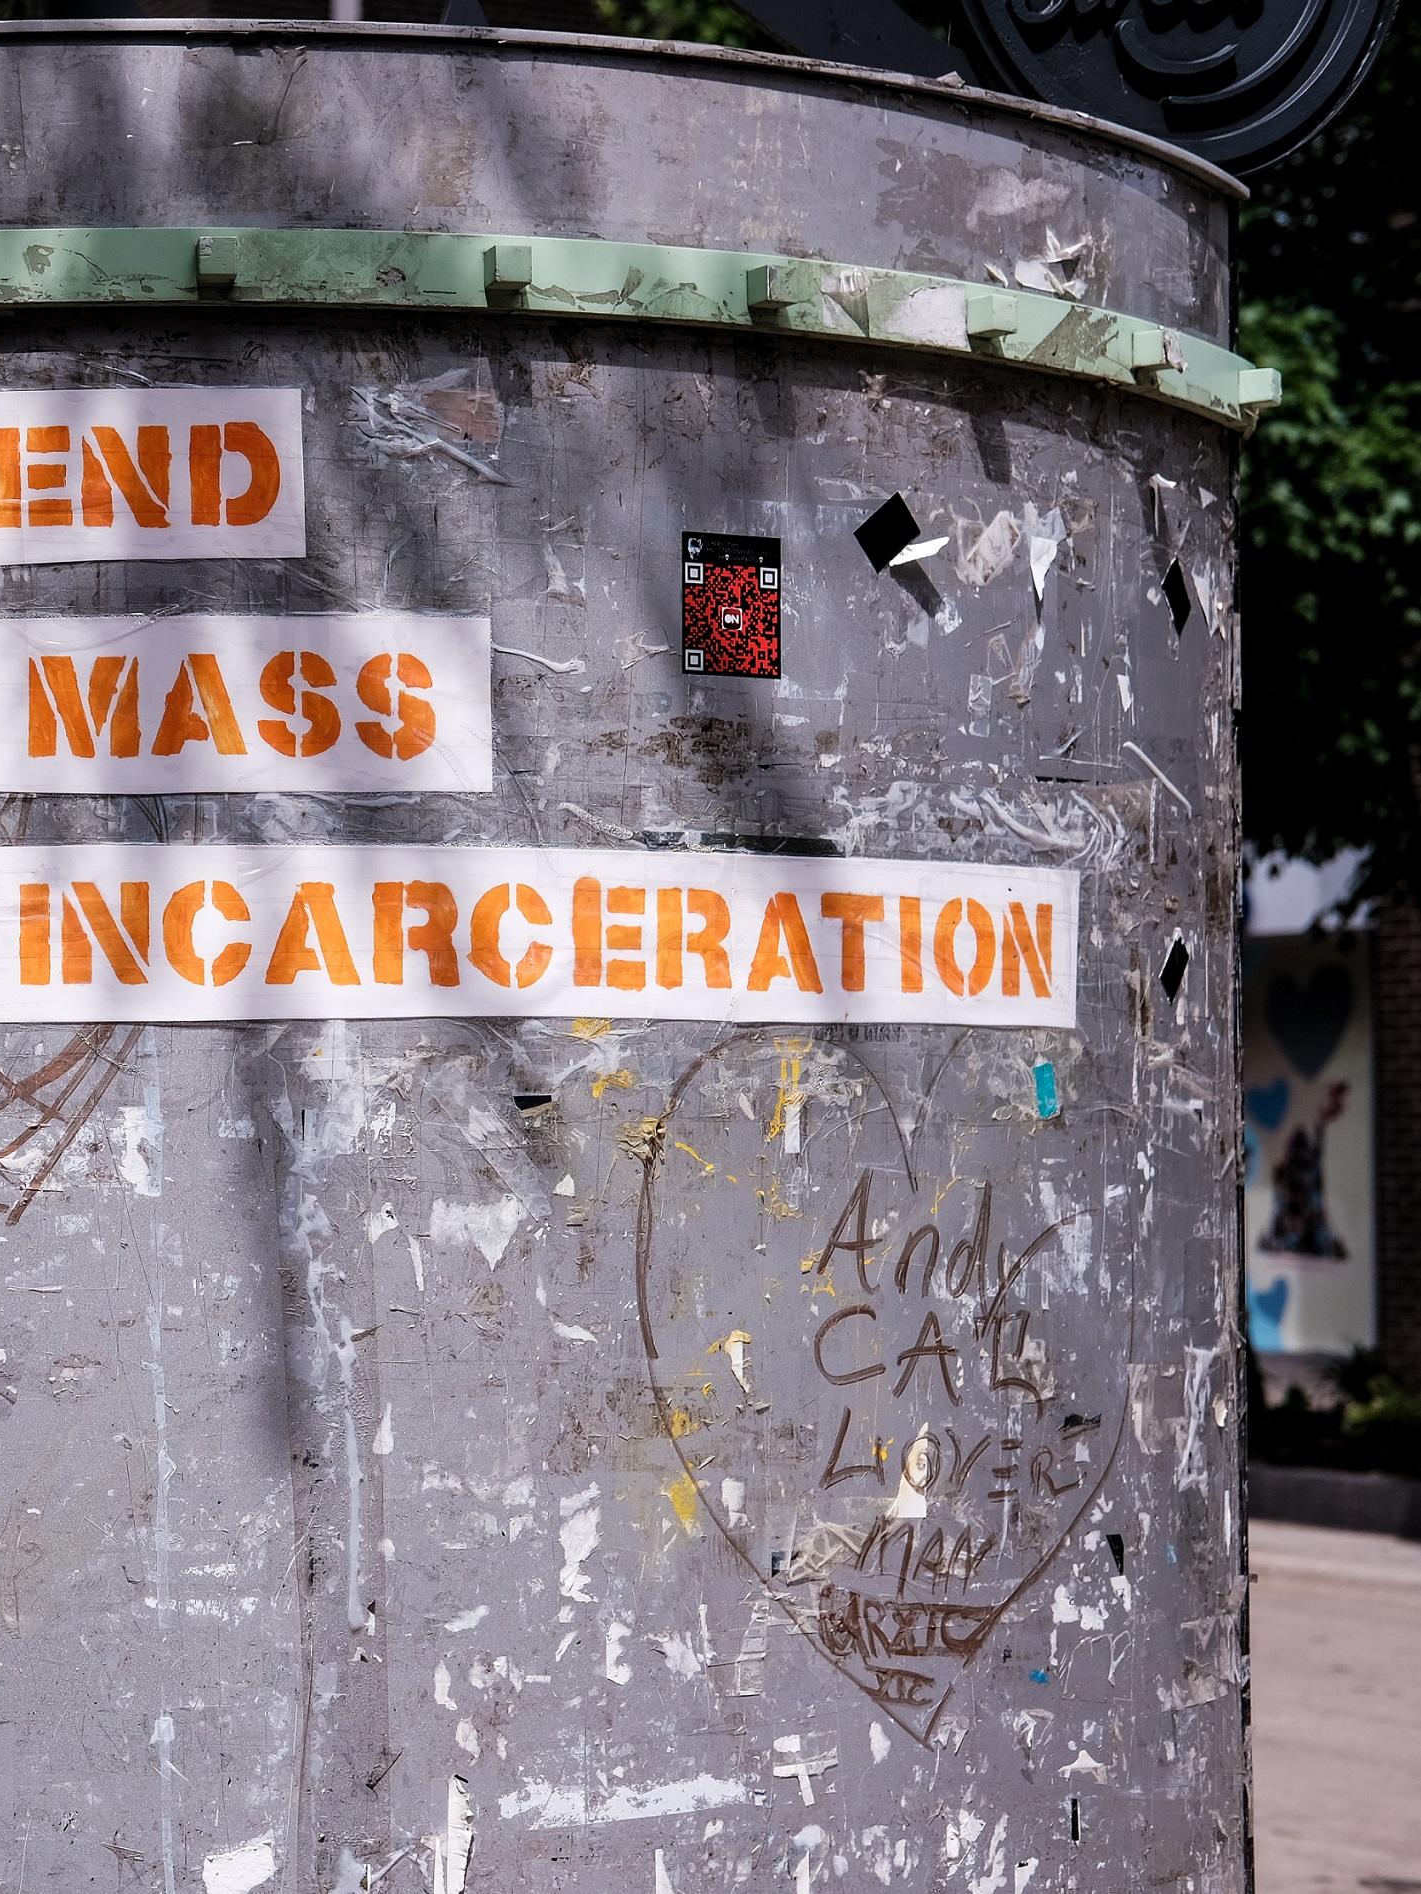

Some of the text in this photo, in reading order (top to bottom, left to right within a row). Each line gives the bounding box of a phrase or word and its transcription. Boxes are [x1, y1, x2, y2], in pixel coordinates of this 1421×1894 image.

[28, 650, 436, 761] MASS
[19, 876, 1053, 999] INCARCERATION
[816, 1168, 1098, 1338] Andy
